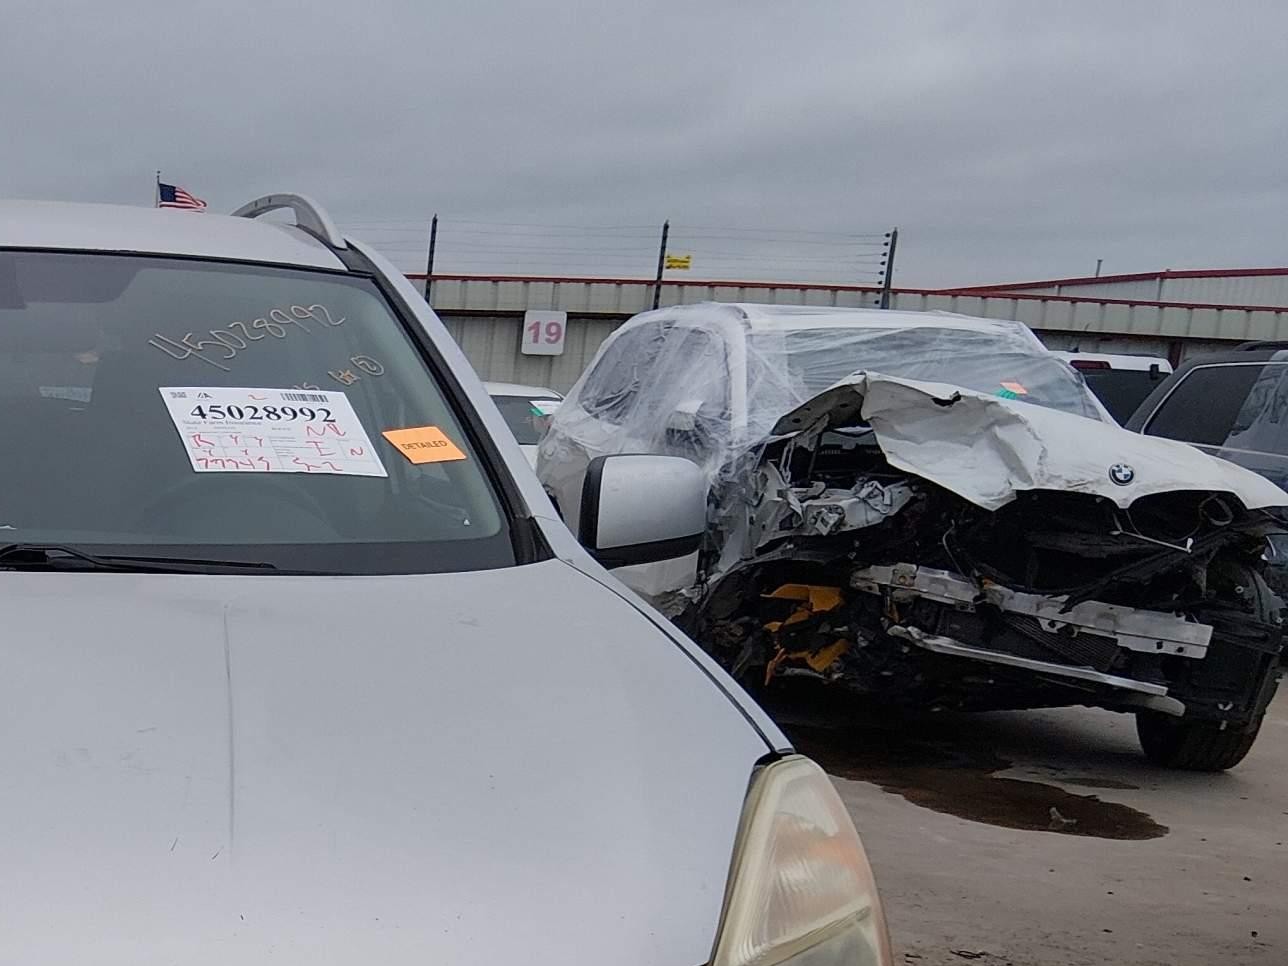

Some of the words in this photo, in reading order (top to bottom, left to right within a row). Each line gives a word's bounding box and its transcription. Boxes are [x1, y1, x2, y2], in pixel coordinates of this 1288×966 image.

[148, 304, 346, 371] 45028992
[527, 320, 562, 344] 19
[190, 404, 336, 423] 45028992
[401, 440, 448, 450] DETAILED
